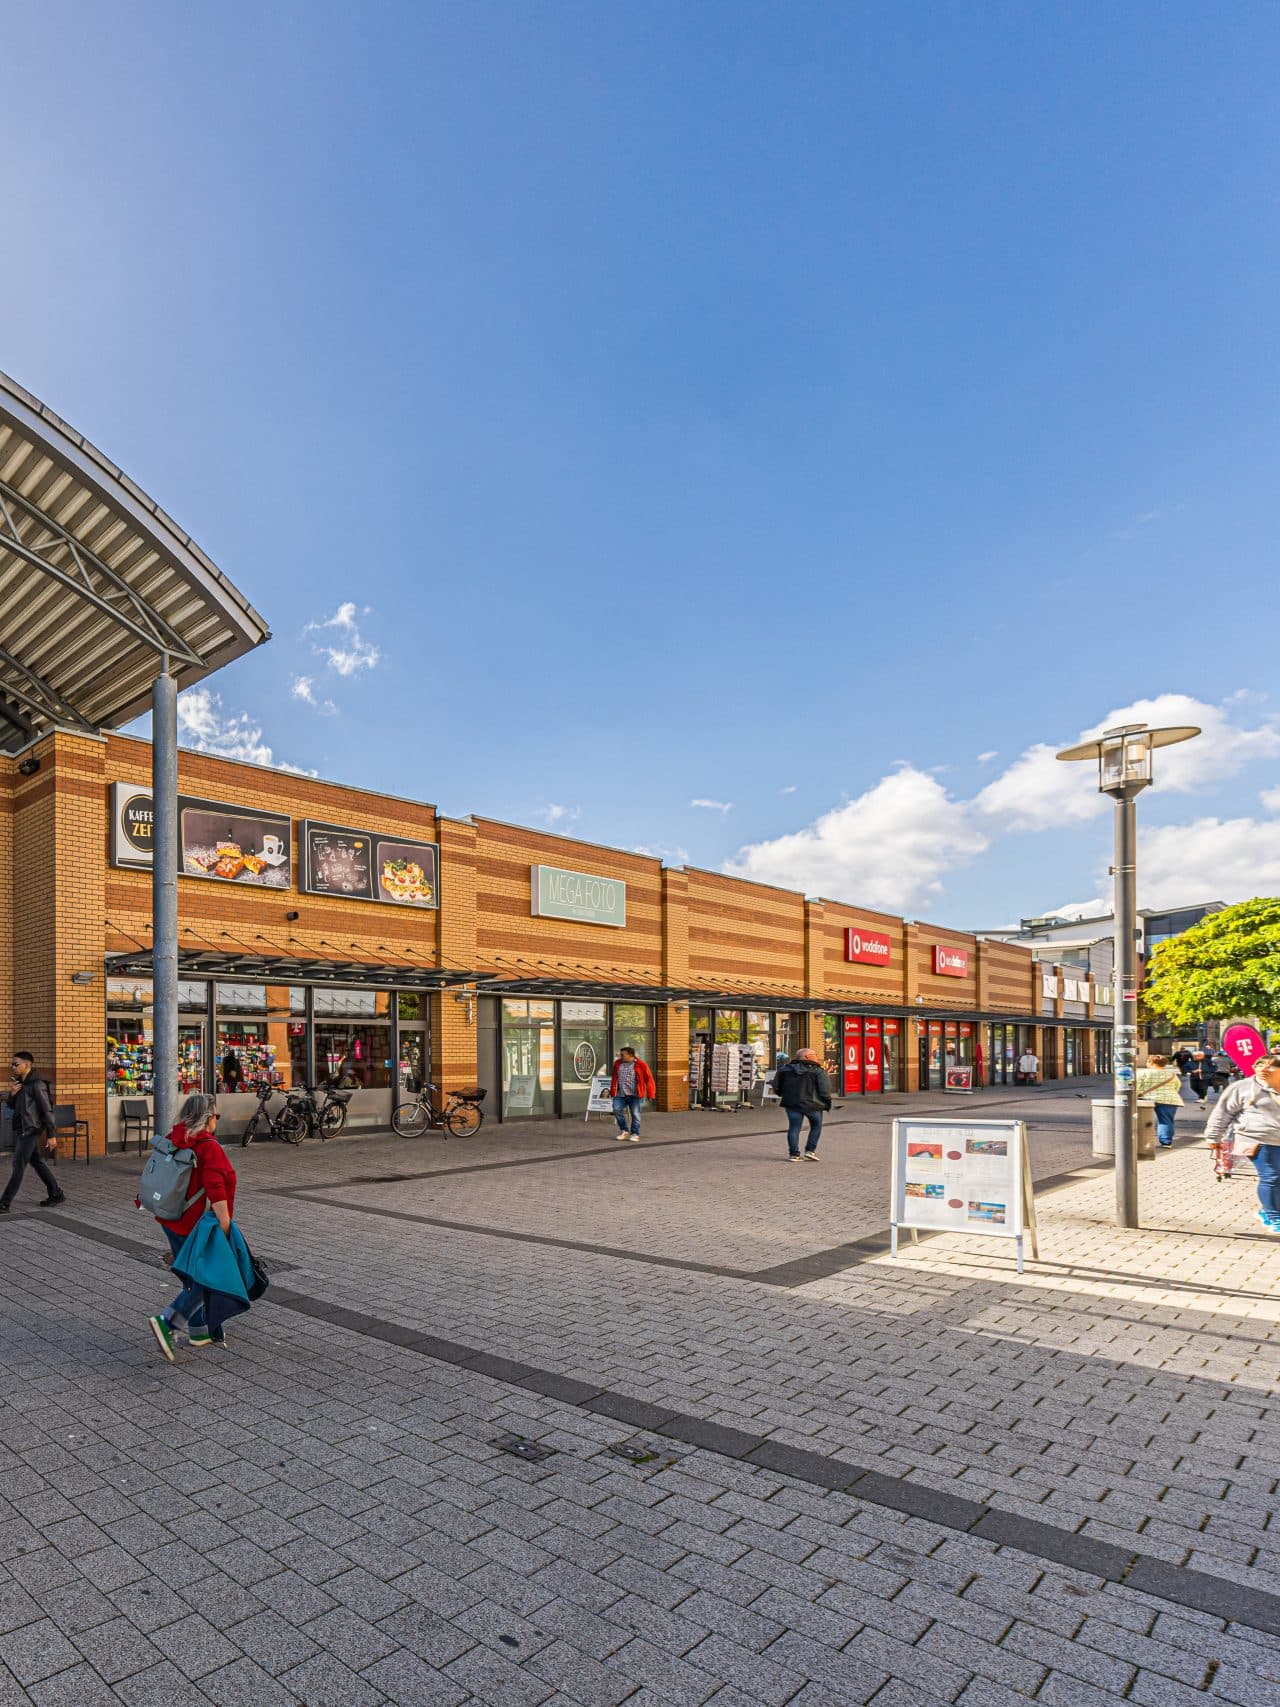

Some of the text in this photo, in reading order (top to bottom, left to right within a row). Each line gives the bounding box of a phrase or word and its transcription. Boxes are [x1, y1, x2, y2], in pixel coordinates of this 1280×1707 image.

[128, 809, 154, 822] KAFFE
[132, 822, 154, 837] ZEI
[549, 873, 616, 911] MEGA FOTO
[861, 939, 889, 956] vodafone
[1235, 1038, 1254, 1057] T
